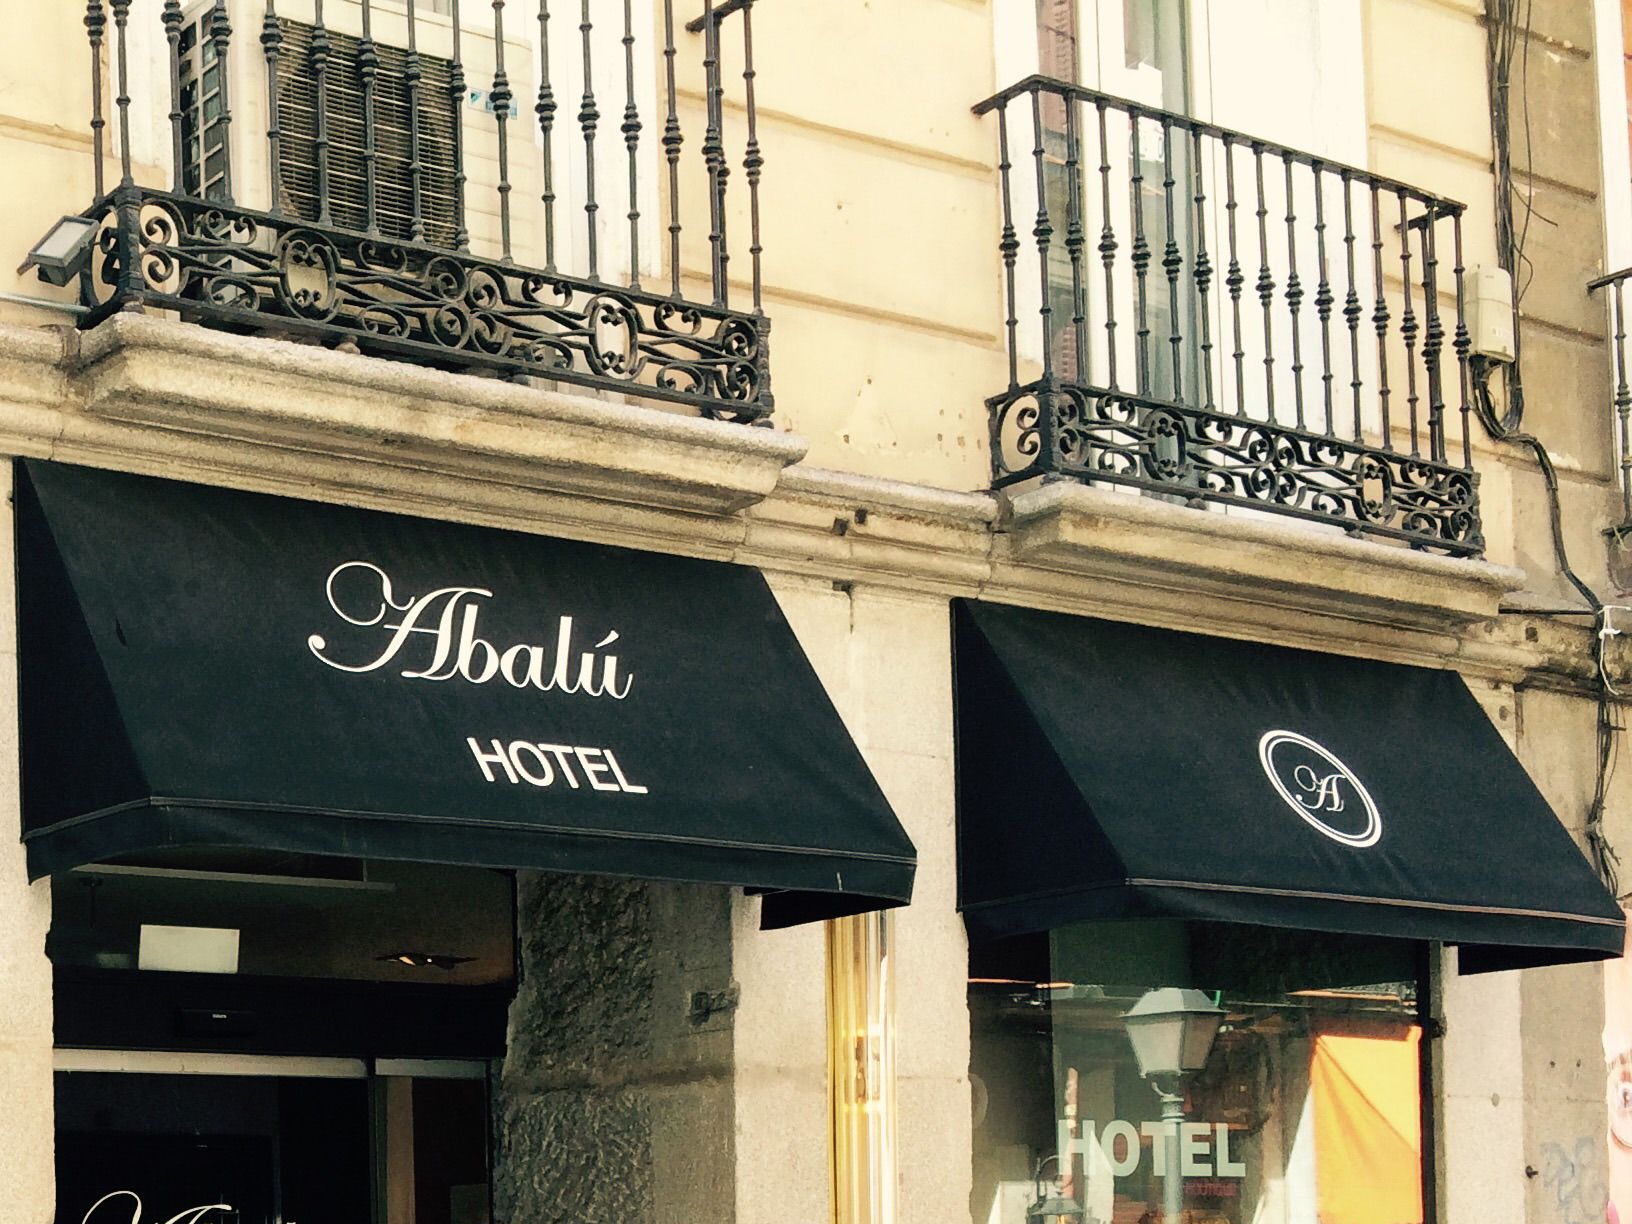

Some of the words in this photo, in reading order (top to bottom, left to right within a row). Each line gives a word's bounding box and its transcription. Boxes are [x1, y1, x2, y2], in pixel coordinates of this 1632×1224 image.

[307, 561, 634, 700] Abalú
[467, 737, 649, 794] HOTEL
[1294, 765, 1348, 812] A
[1057, 1119, 1246, 1178] HOTEL
